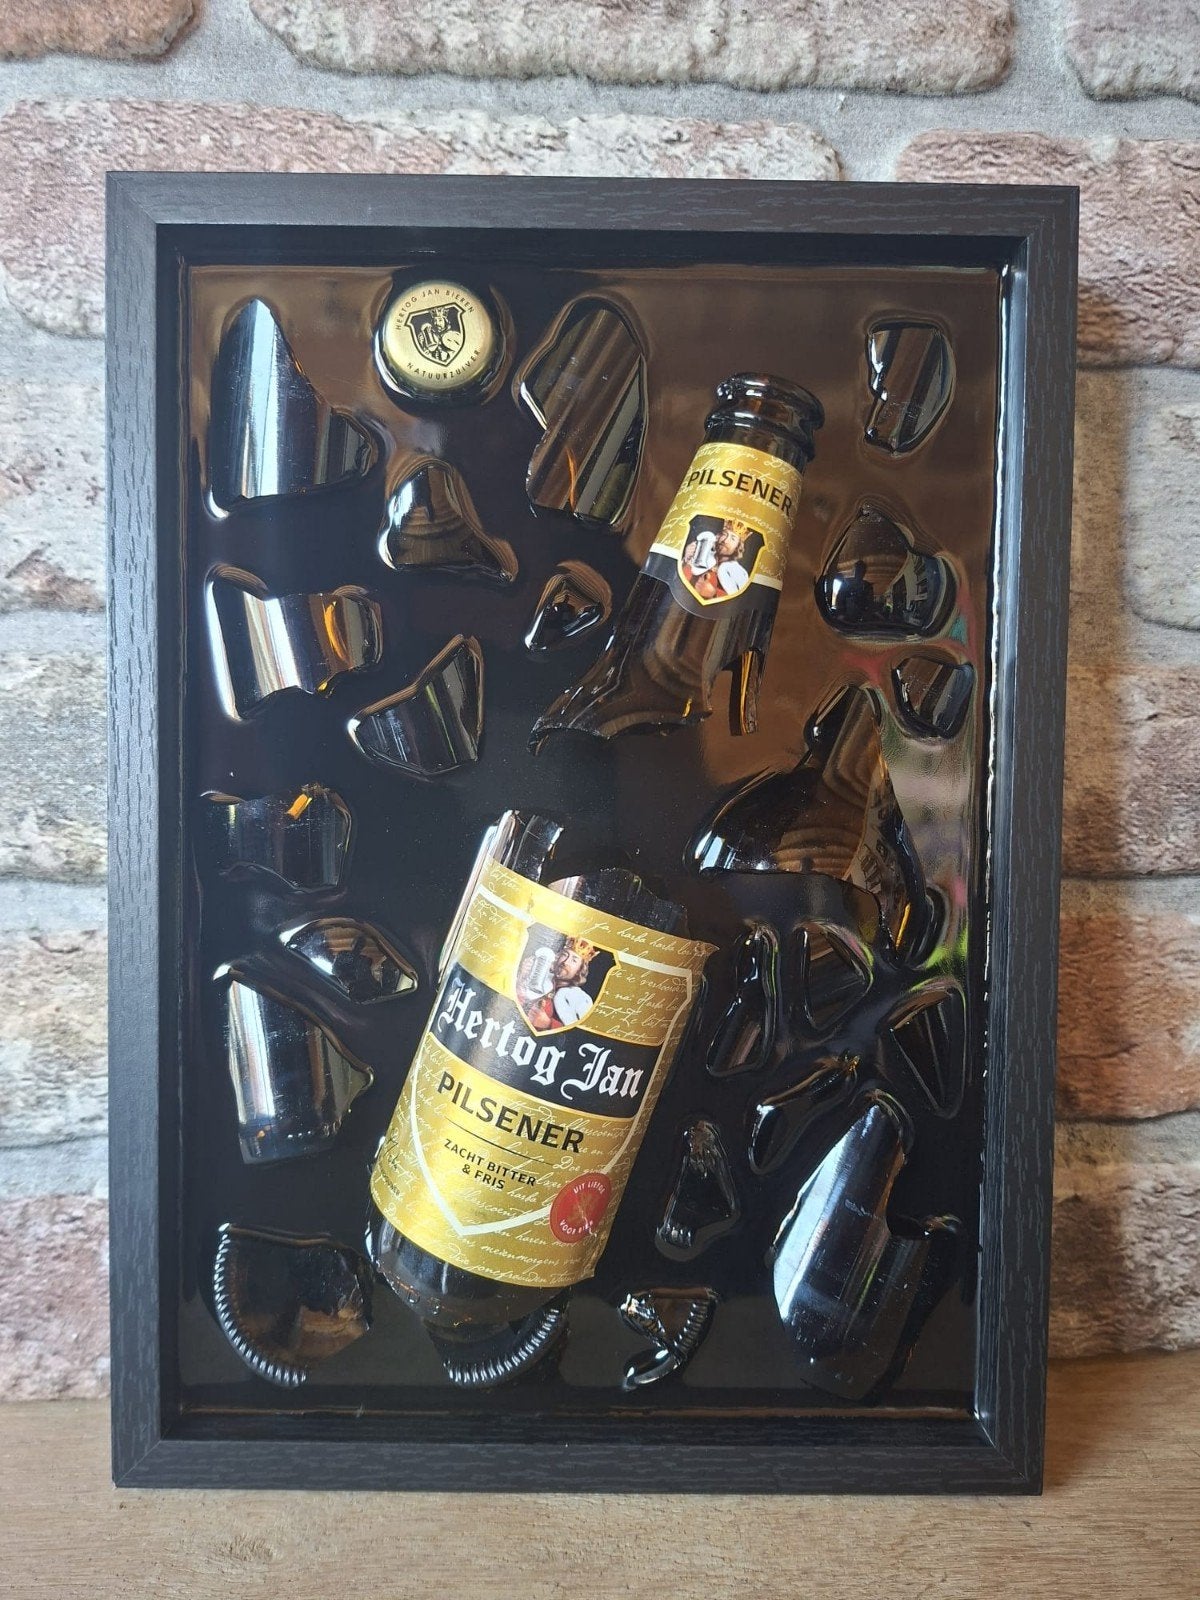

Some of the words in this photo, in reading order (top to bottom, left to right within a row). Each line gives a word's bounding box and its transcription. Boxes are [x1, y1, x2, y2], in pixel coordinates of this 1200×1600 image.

[395, 296, 418, 331] HERTOG
[422, 288, 440, 298] JAN
[445, 289, 475, 314] BIEREN
[406, 349, 481, 380] NATUURZUIVER
[687, 469, 793, 517] PILSENER
[437, 977, 566, 1086] Hertog
[560, 1042, 645, 1100] Jan
[436, 1071, 585, 1153] PILSENER
[443, 1138, 485, 1166] ZACHT
[486, 1161, 537, 1187] BITTER
[461, 1163, 471, 1175] &
[474, 1169, 506, 1190] FRIS
[573, 1182, 586, 1194] UIT
[559, 1219, 577, 1235] VOOR
